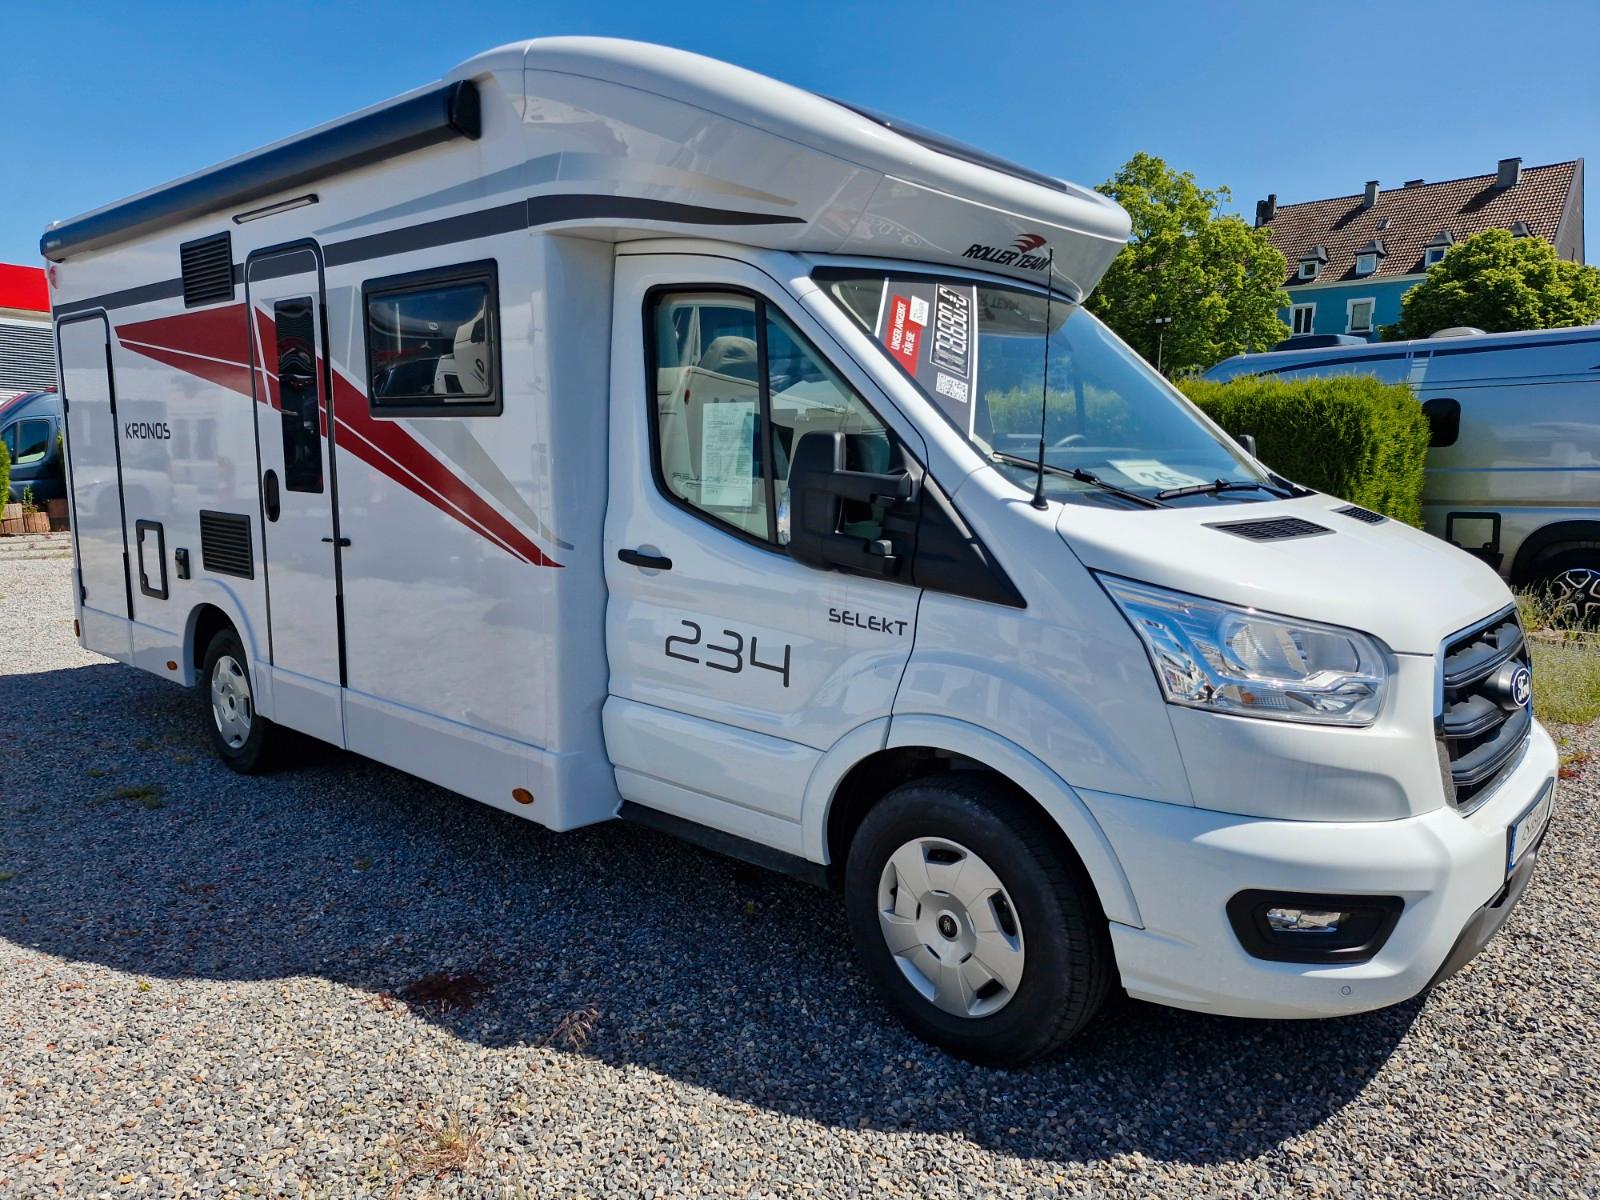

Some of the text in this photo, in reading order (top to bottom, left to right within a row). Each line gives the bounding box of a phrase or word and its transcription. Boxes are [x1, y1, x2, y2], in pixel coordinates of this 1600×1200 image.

[962, 243, 1052, 272] ROLLER TEAM
[890, 301, 907, 351] UNSER ANGEBOT
[902, 341, 914, 356] FÜR
[125, 422, 171, 440] KRONOS
[828, 607, 909, 636] SELEKT
[665, 619, 791, 688] 234
